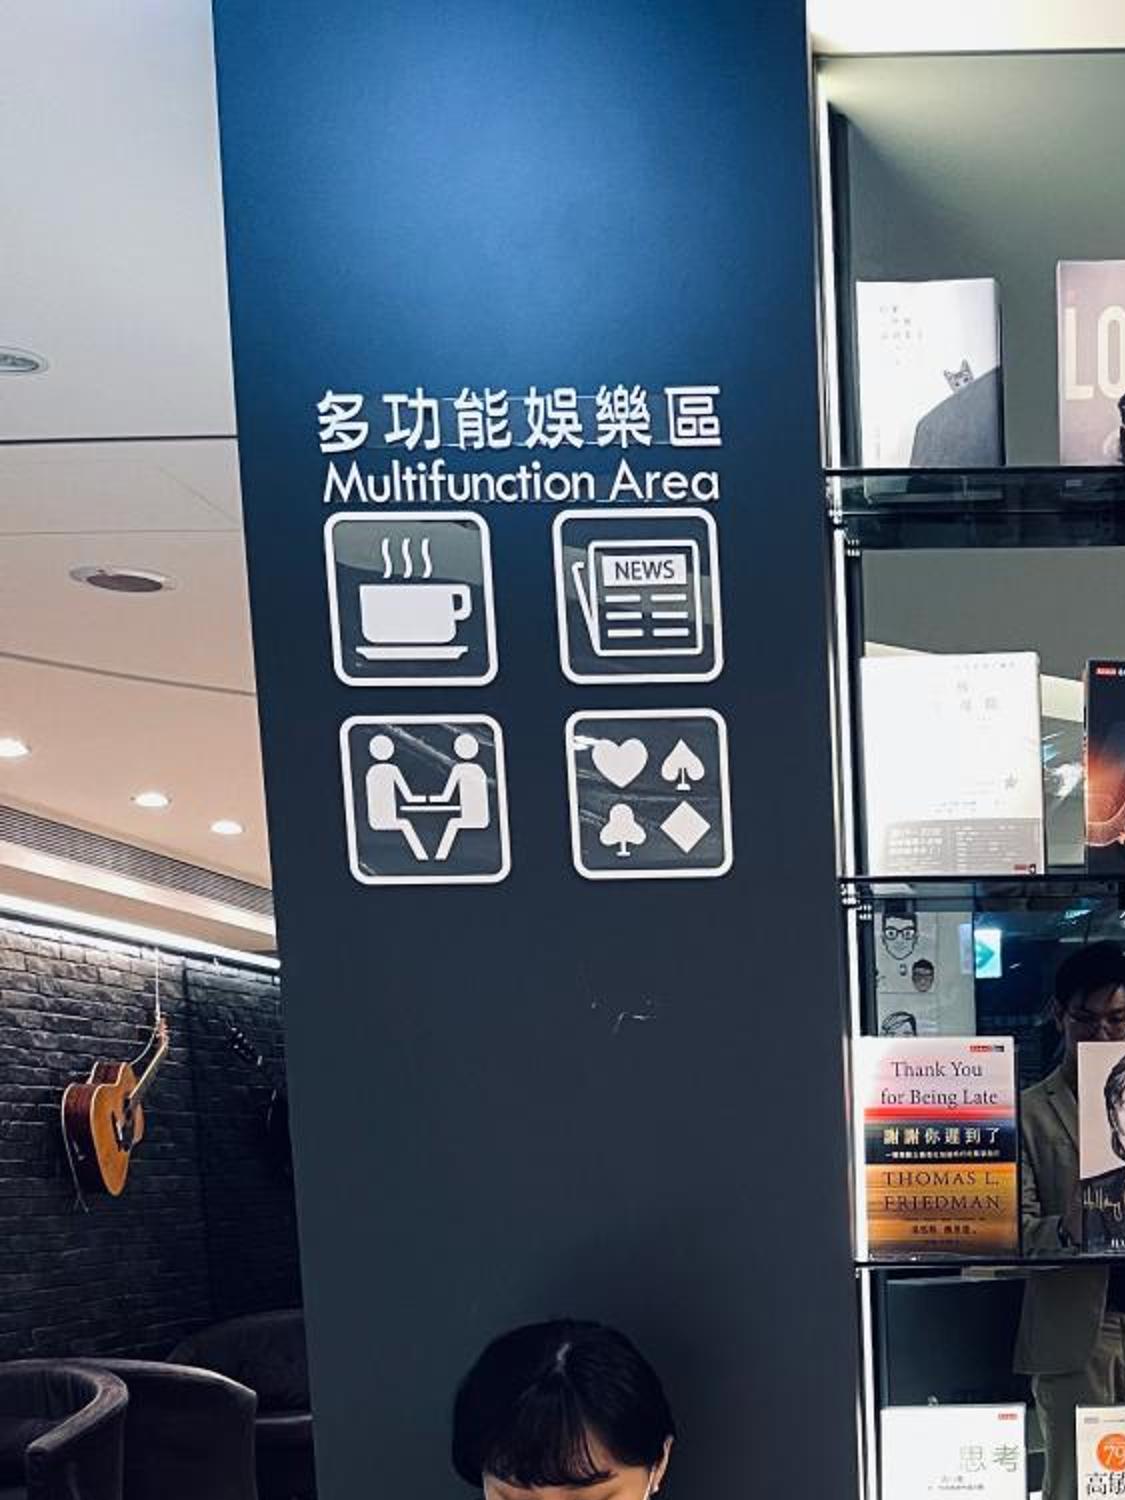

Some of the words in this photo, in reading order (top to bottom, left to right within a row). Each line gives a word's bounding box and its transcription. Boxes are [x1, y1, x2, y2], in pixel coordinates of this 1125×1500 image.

[316, 384, 723, 453] 多功能娛樂區
[323, 459, 596, 503] Multifunction
[609, 457, 721, 502] Area
[614, 558, 675, 581] NEWS
[891, 1061, 945, 1079] Thank
[950, 1061, 983, 1079] You
[881, 1089, 905, 1106] for
[910, 1089, 959, 1110] Being
[963, 1089, 999, 1106] Late
[882, 1171, 976, 1186] THOMAS
[884, 1195, 1001, 1211] FRIEDMAN
[959, 1444, 1020, 1473] 思考
